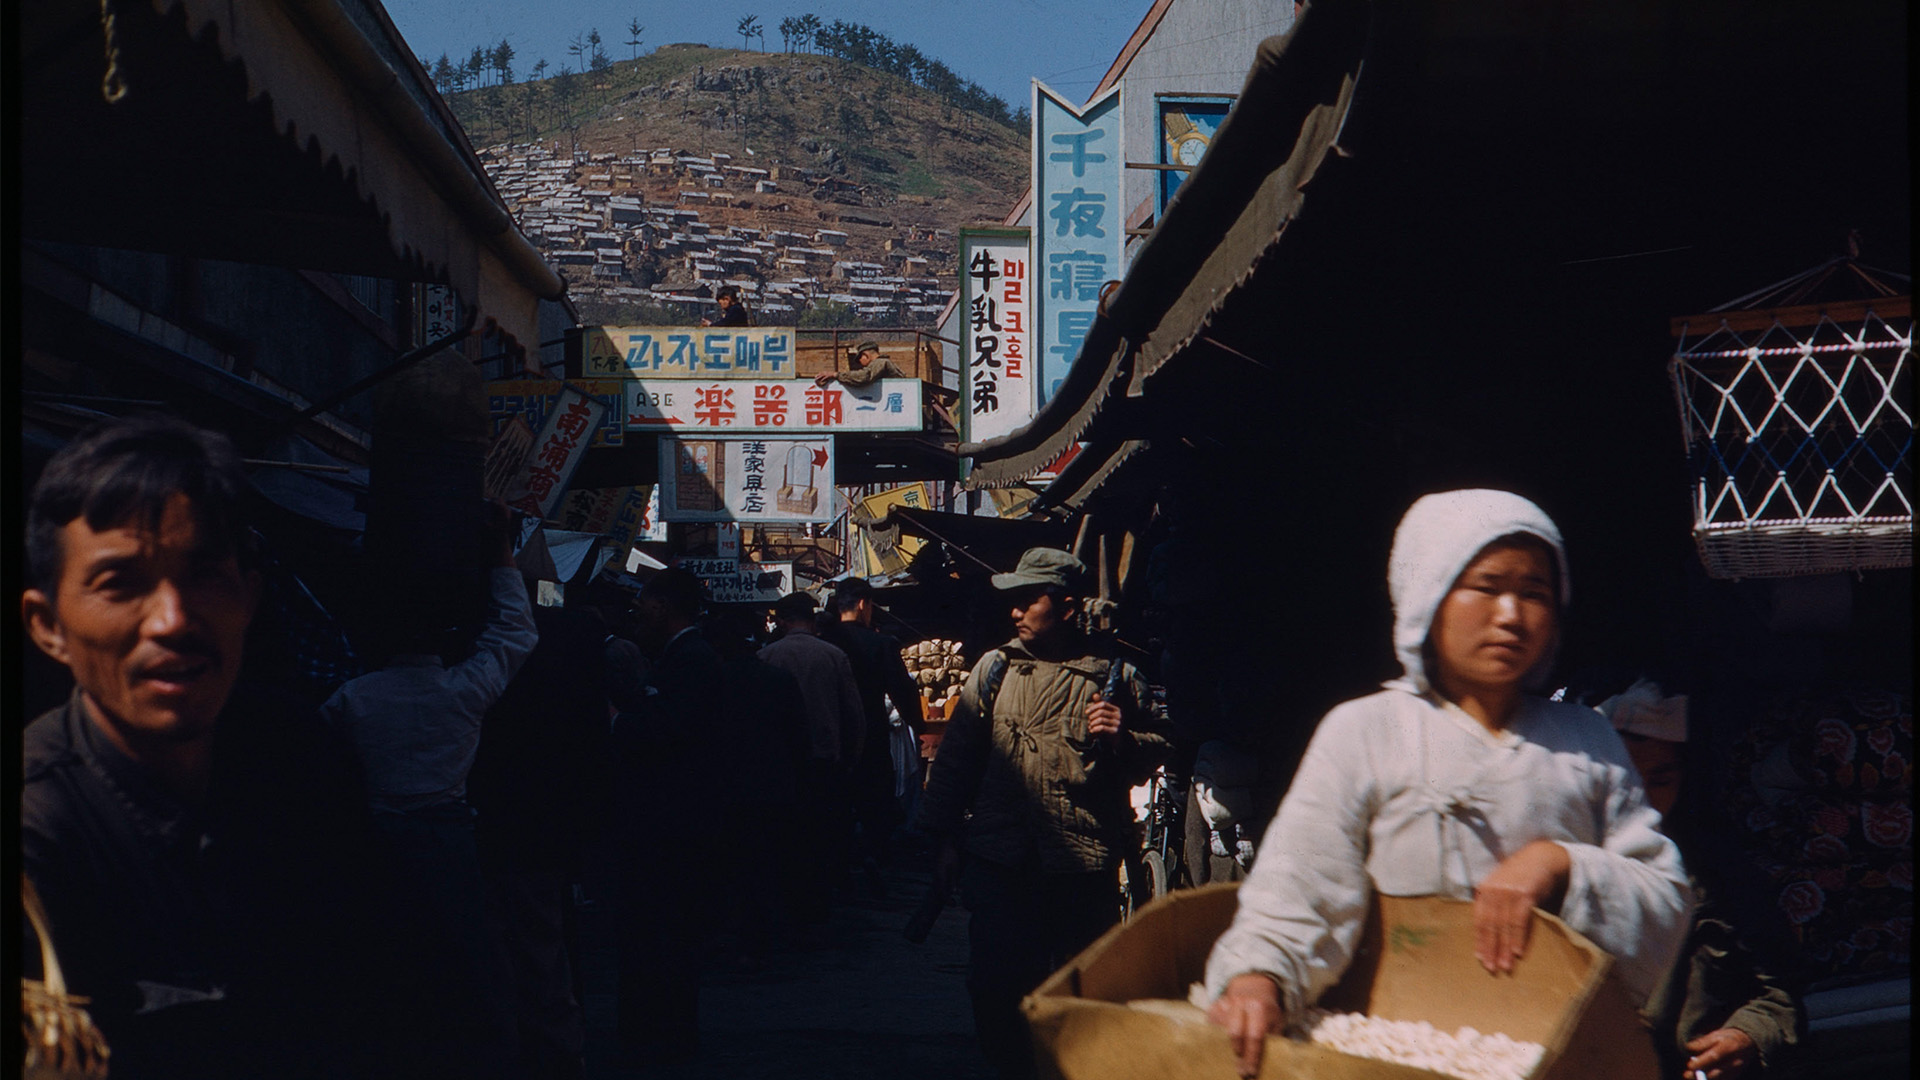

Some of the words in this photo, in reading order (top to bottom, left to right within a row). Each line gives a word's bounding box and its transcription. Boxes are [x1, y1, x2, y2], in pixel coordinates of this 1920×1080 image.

[969, 249, 1001, 415] 牛乳兄弟
[1003, 258, 1024, 378] 밀크홀
[1049, 128, 1106, 395] 千夜寢具
